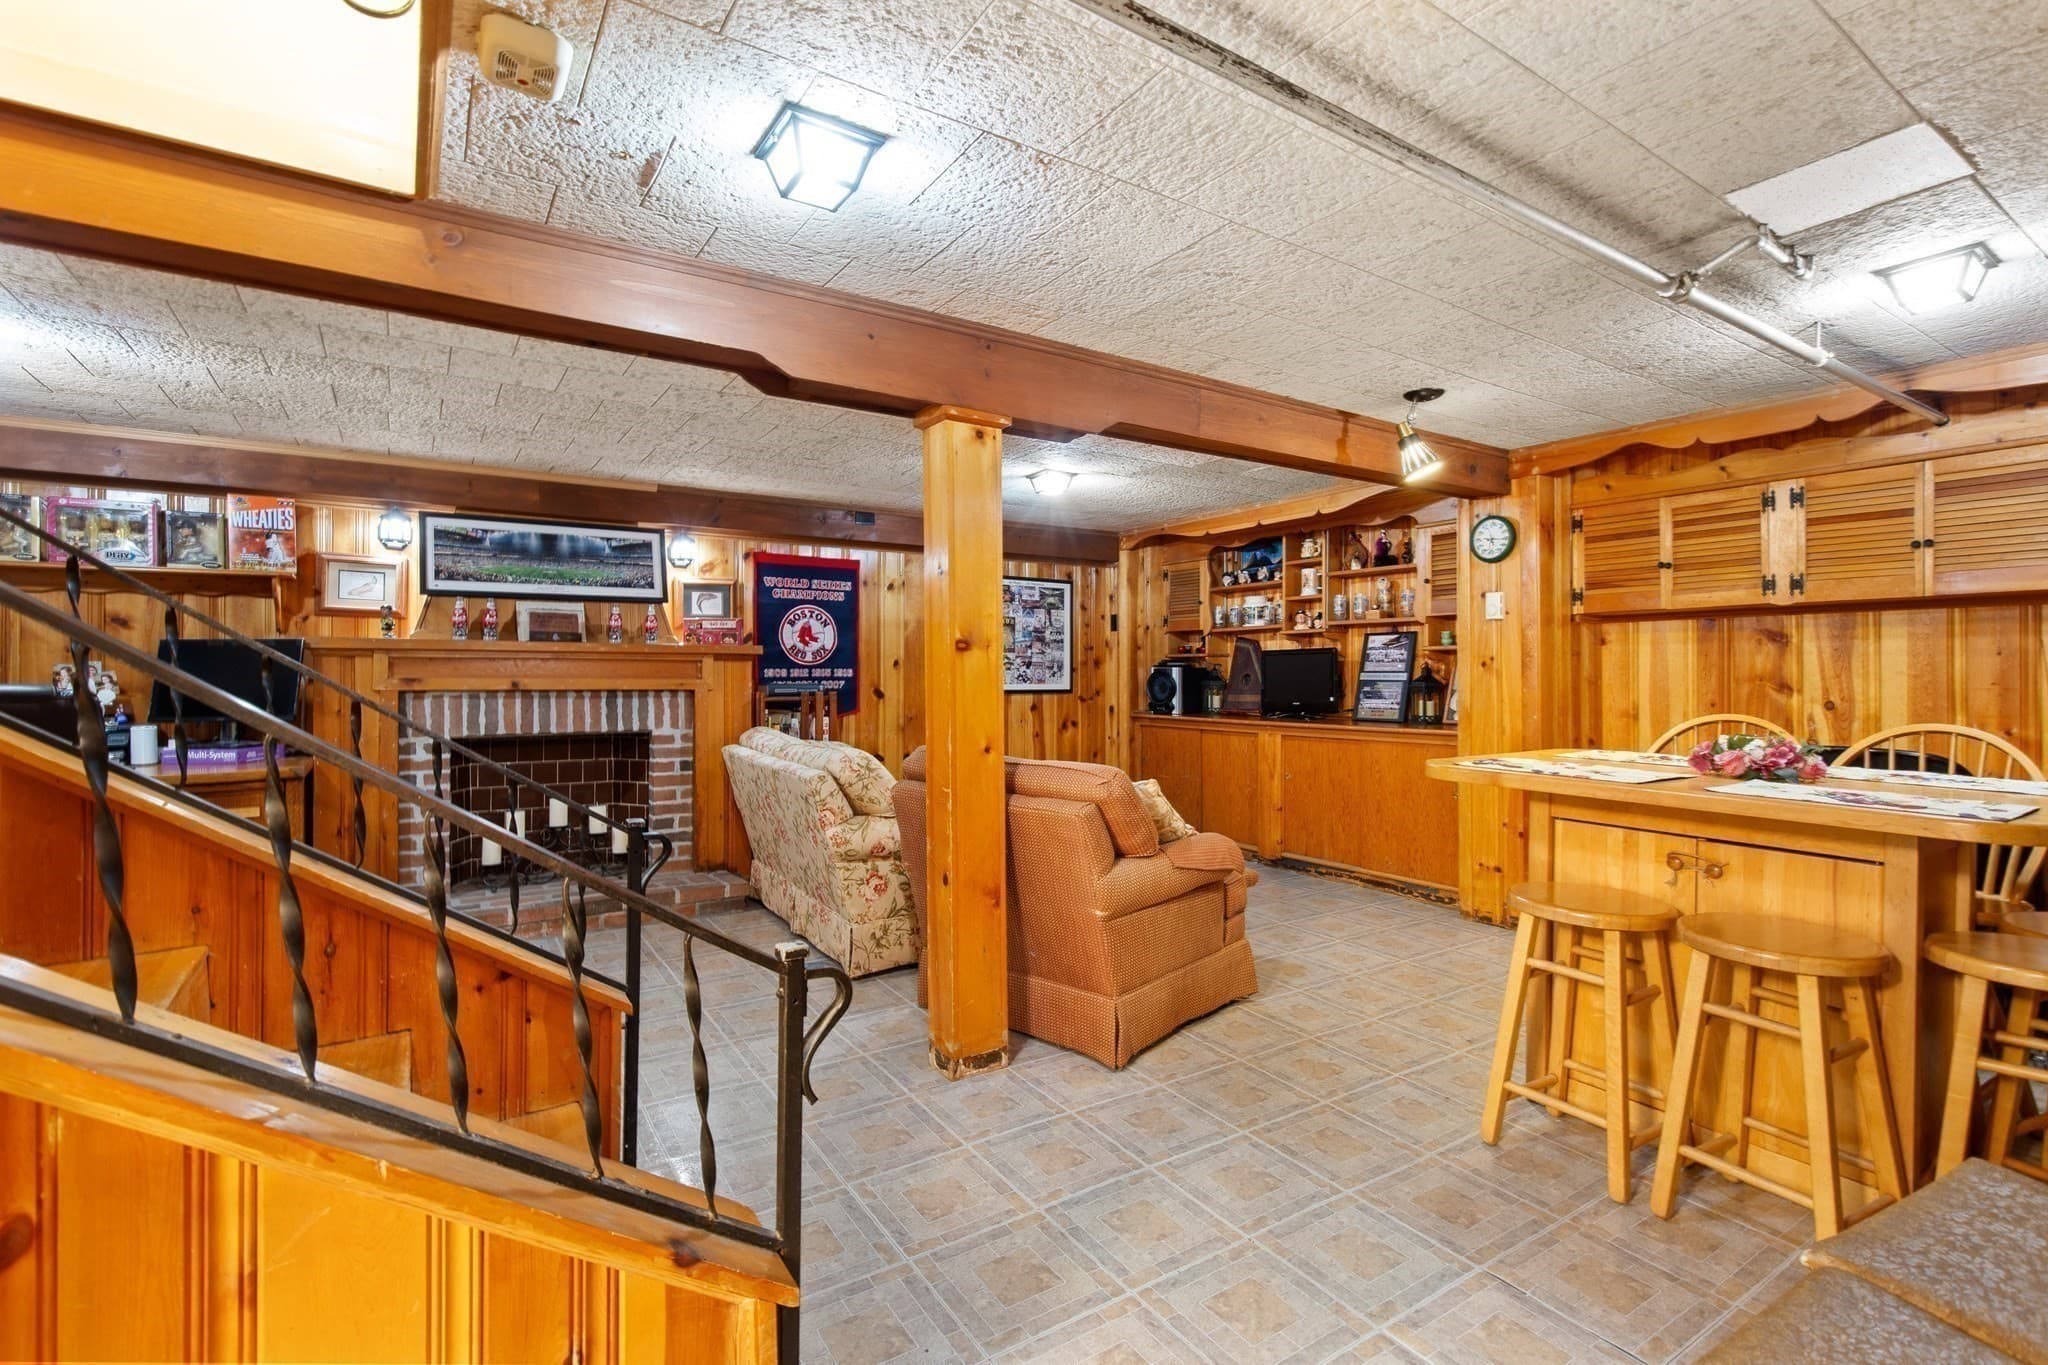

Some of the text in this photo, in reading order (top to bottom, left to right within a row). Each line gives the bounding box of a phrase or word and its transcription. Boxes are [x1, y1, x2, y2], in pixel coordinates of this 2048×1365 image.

[231, 507, 294, 531] WHEATIES
[763, 576, 810, 589] WORLD
[772, 588, 845, 601] CHAMPIONS
[787, 610, 830, 627] BOSTON
[788, 645, 829, 660] RED SOX
[187, 750, 236, 761] Multi-System
